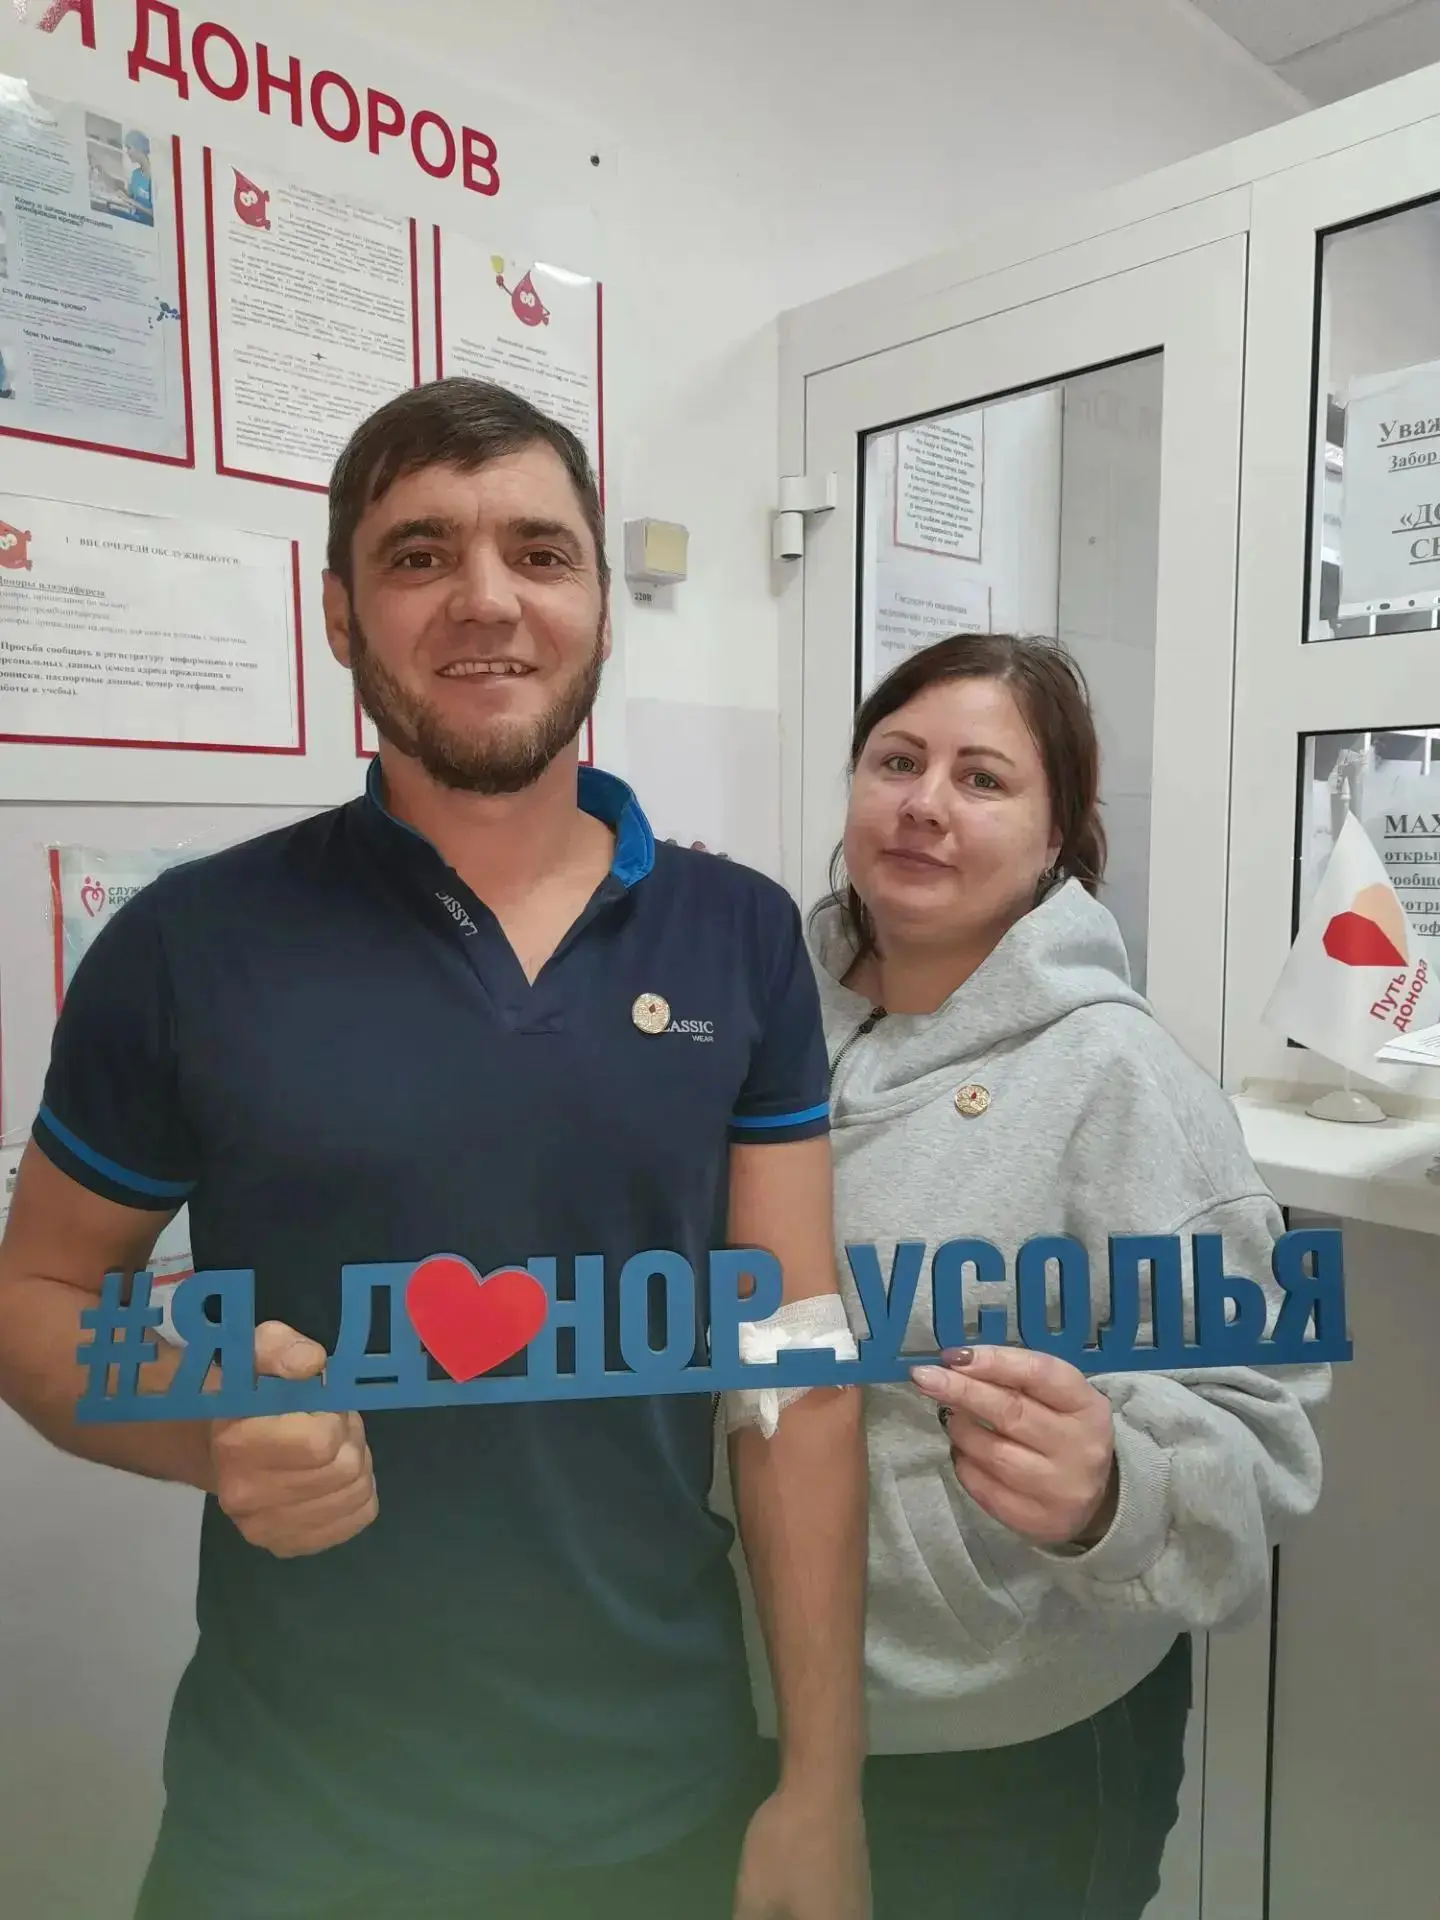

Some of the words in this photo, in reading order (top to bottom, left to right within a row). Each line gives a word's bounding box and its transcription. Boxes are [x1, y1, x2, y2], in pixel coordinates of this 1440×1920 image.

[127, 0, 500, 197] ДОНОРОВ
[1389, 450, 1438, 470] Забор
[1384, 851, 1440, 863] откры
[1369, 973, 1407, 1021] Путь
[1393, 958, 1429, 1033] донора
[662, 1020, 714, 1034] ASSIC
[691, 1034, 714, 1043] WEAR
